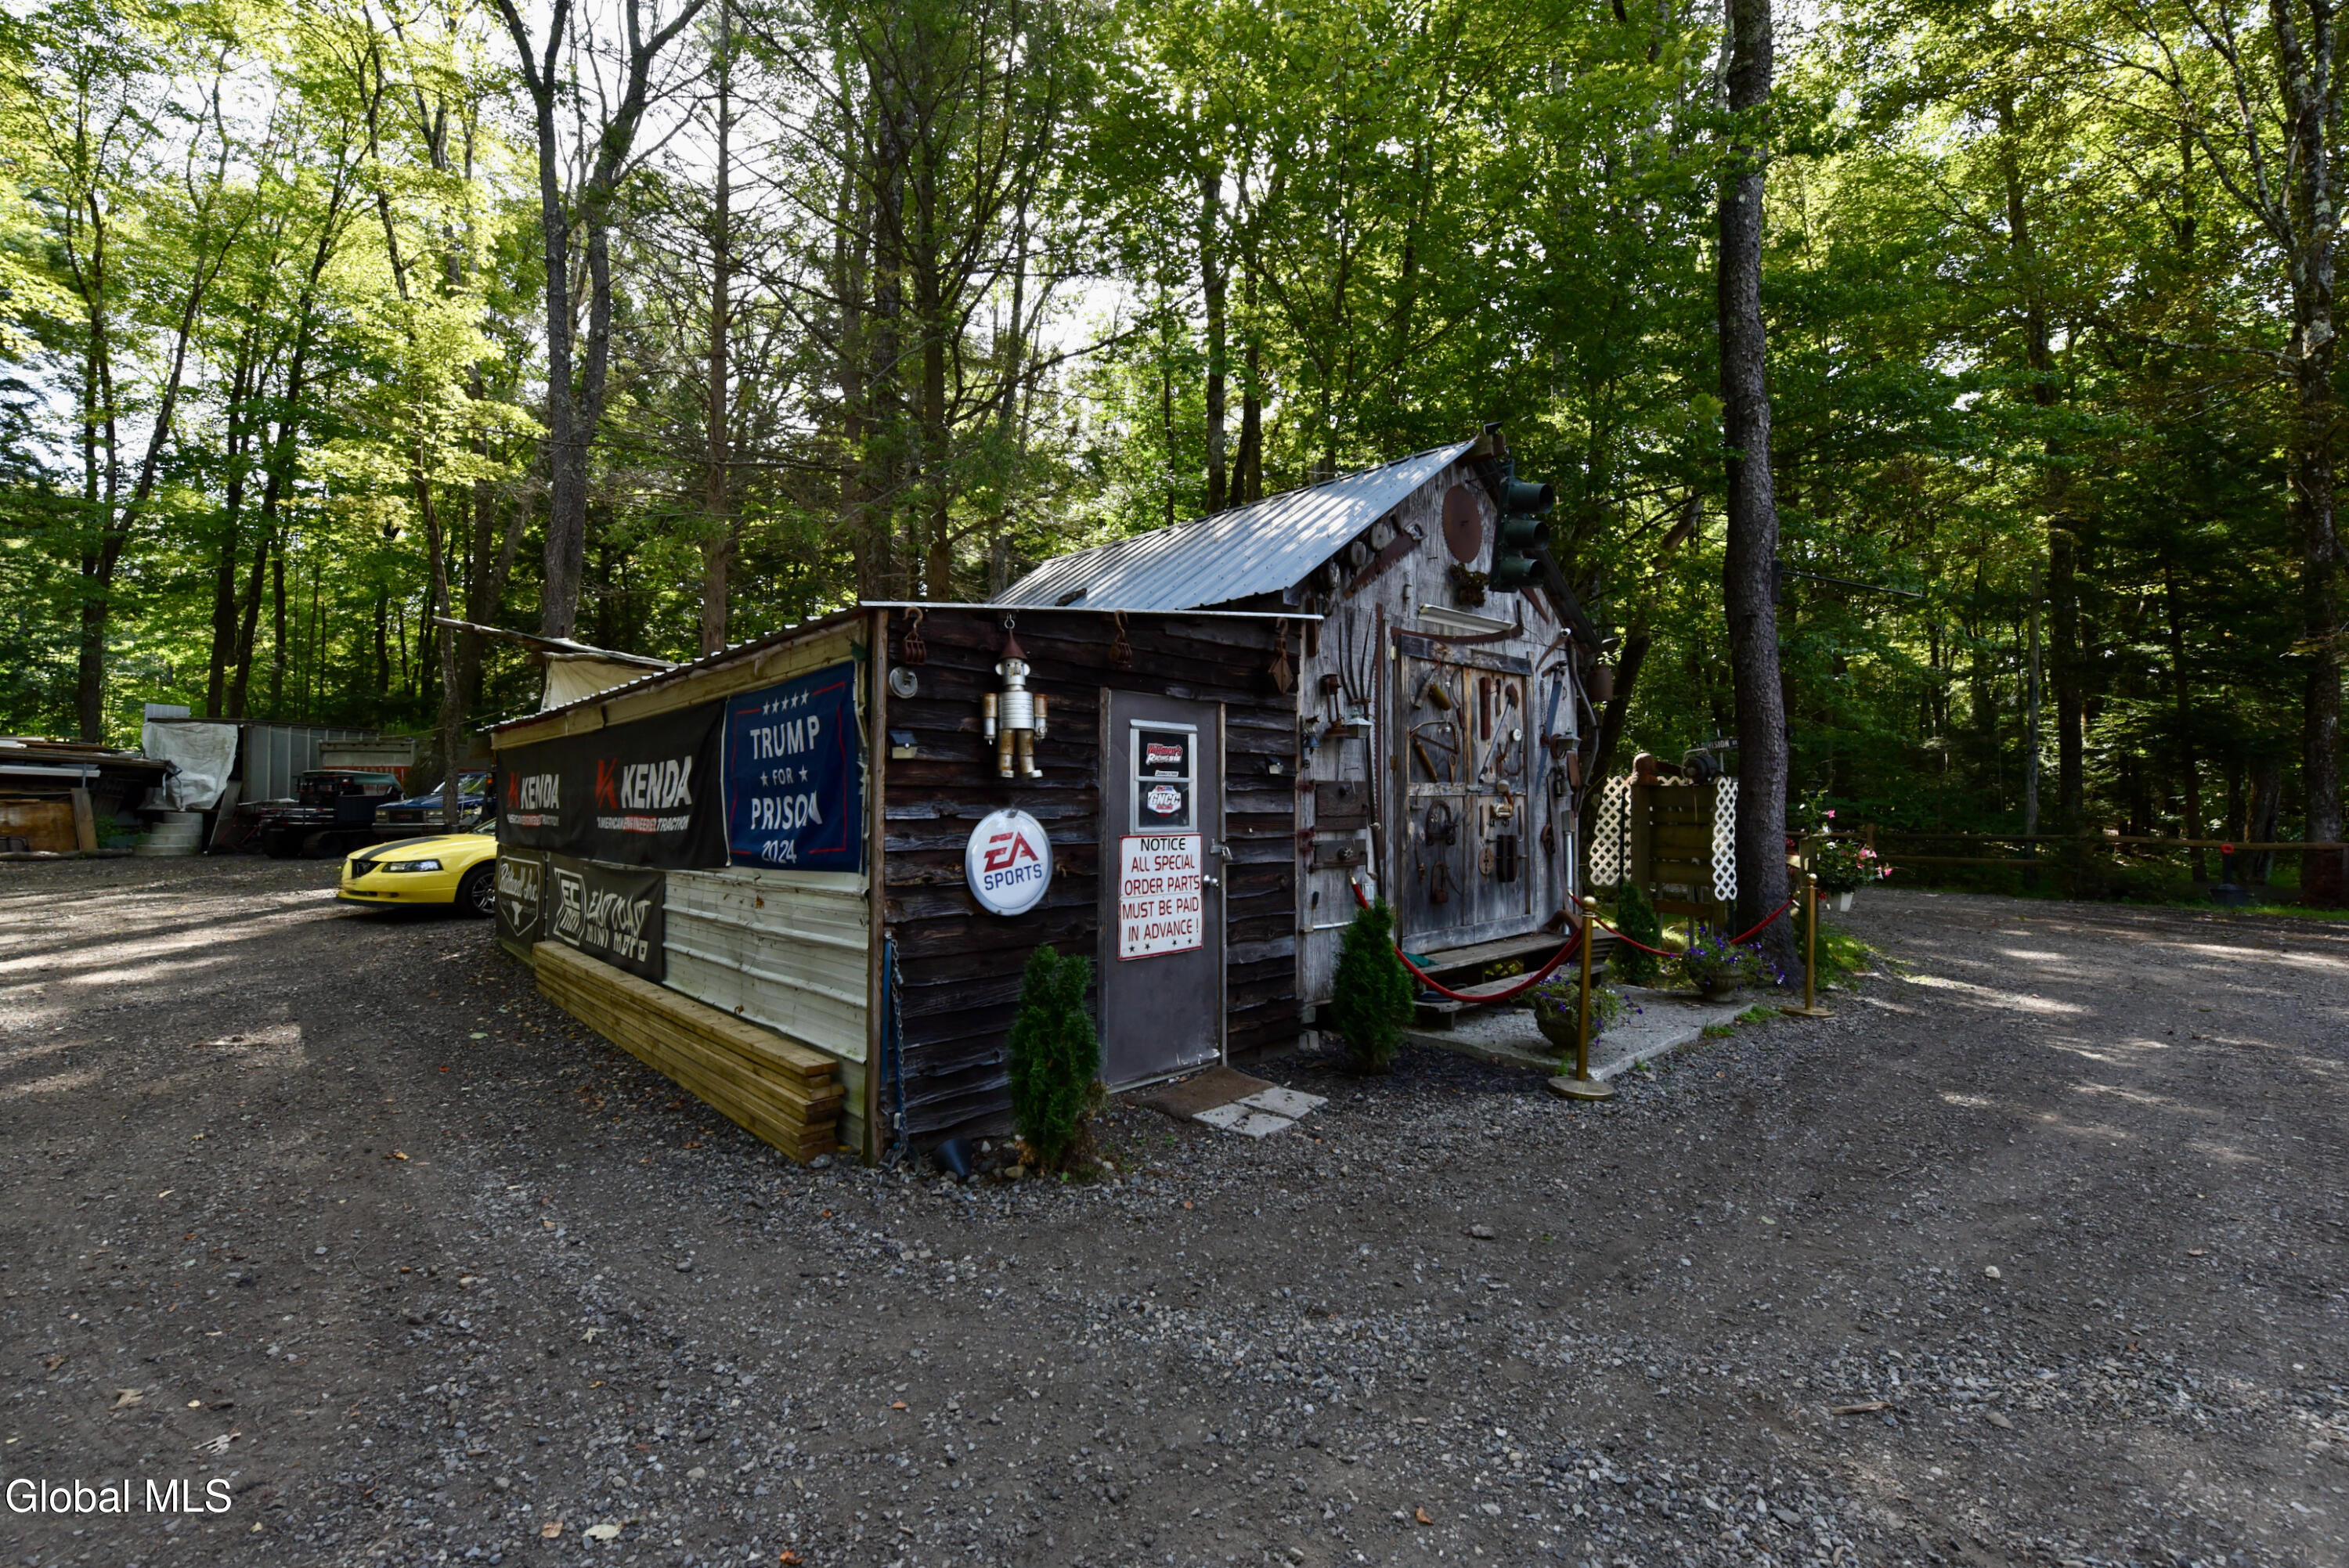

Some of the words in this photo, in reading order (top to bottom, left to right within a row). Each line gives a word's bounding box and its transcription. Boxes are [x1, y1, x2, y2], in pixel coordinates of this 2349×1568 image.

[750, 715, 820, 759] TRUMP
[620, 755, 692, 809] KENDA
[772, 767, 793, 785] FOR
[521, 773, 560, 809] KENDA
[1149, 792, 1181, 806] GNCC
[751, 789, 822, 831] PRISON
[761, 839, 797, 864] 2024
[983, 831, 1039, 873] EA
[1141, 838, 1186, 851] NOTICE
[1131, 856, 1150, 873] ALL
[1154, 854, 1195, 871] SPECIAL
[983, 863, 1042, 891] SPORTS
[1124, 878, 1164, 896] ORDER
[1167, 875, 1200, 892] PARTS
[587, 886, 618, 929] EAST
[611, 892, 651, 943] COAST
[1122, 901, 1155, 921] MUST
[1159, 899, 1172, 916] BE
[1177, 896, 1199, 914] PAID
[586, 923, 610, 949] MINI
[613, 932, 649, 962] MOTO
[1128, 925, 1139, 943] IN
[1144, 919, 1193, 940] ADVANCE
